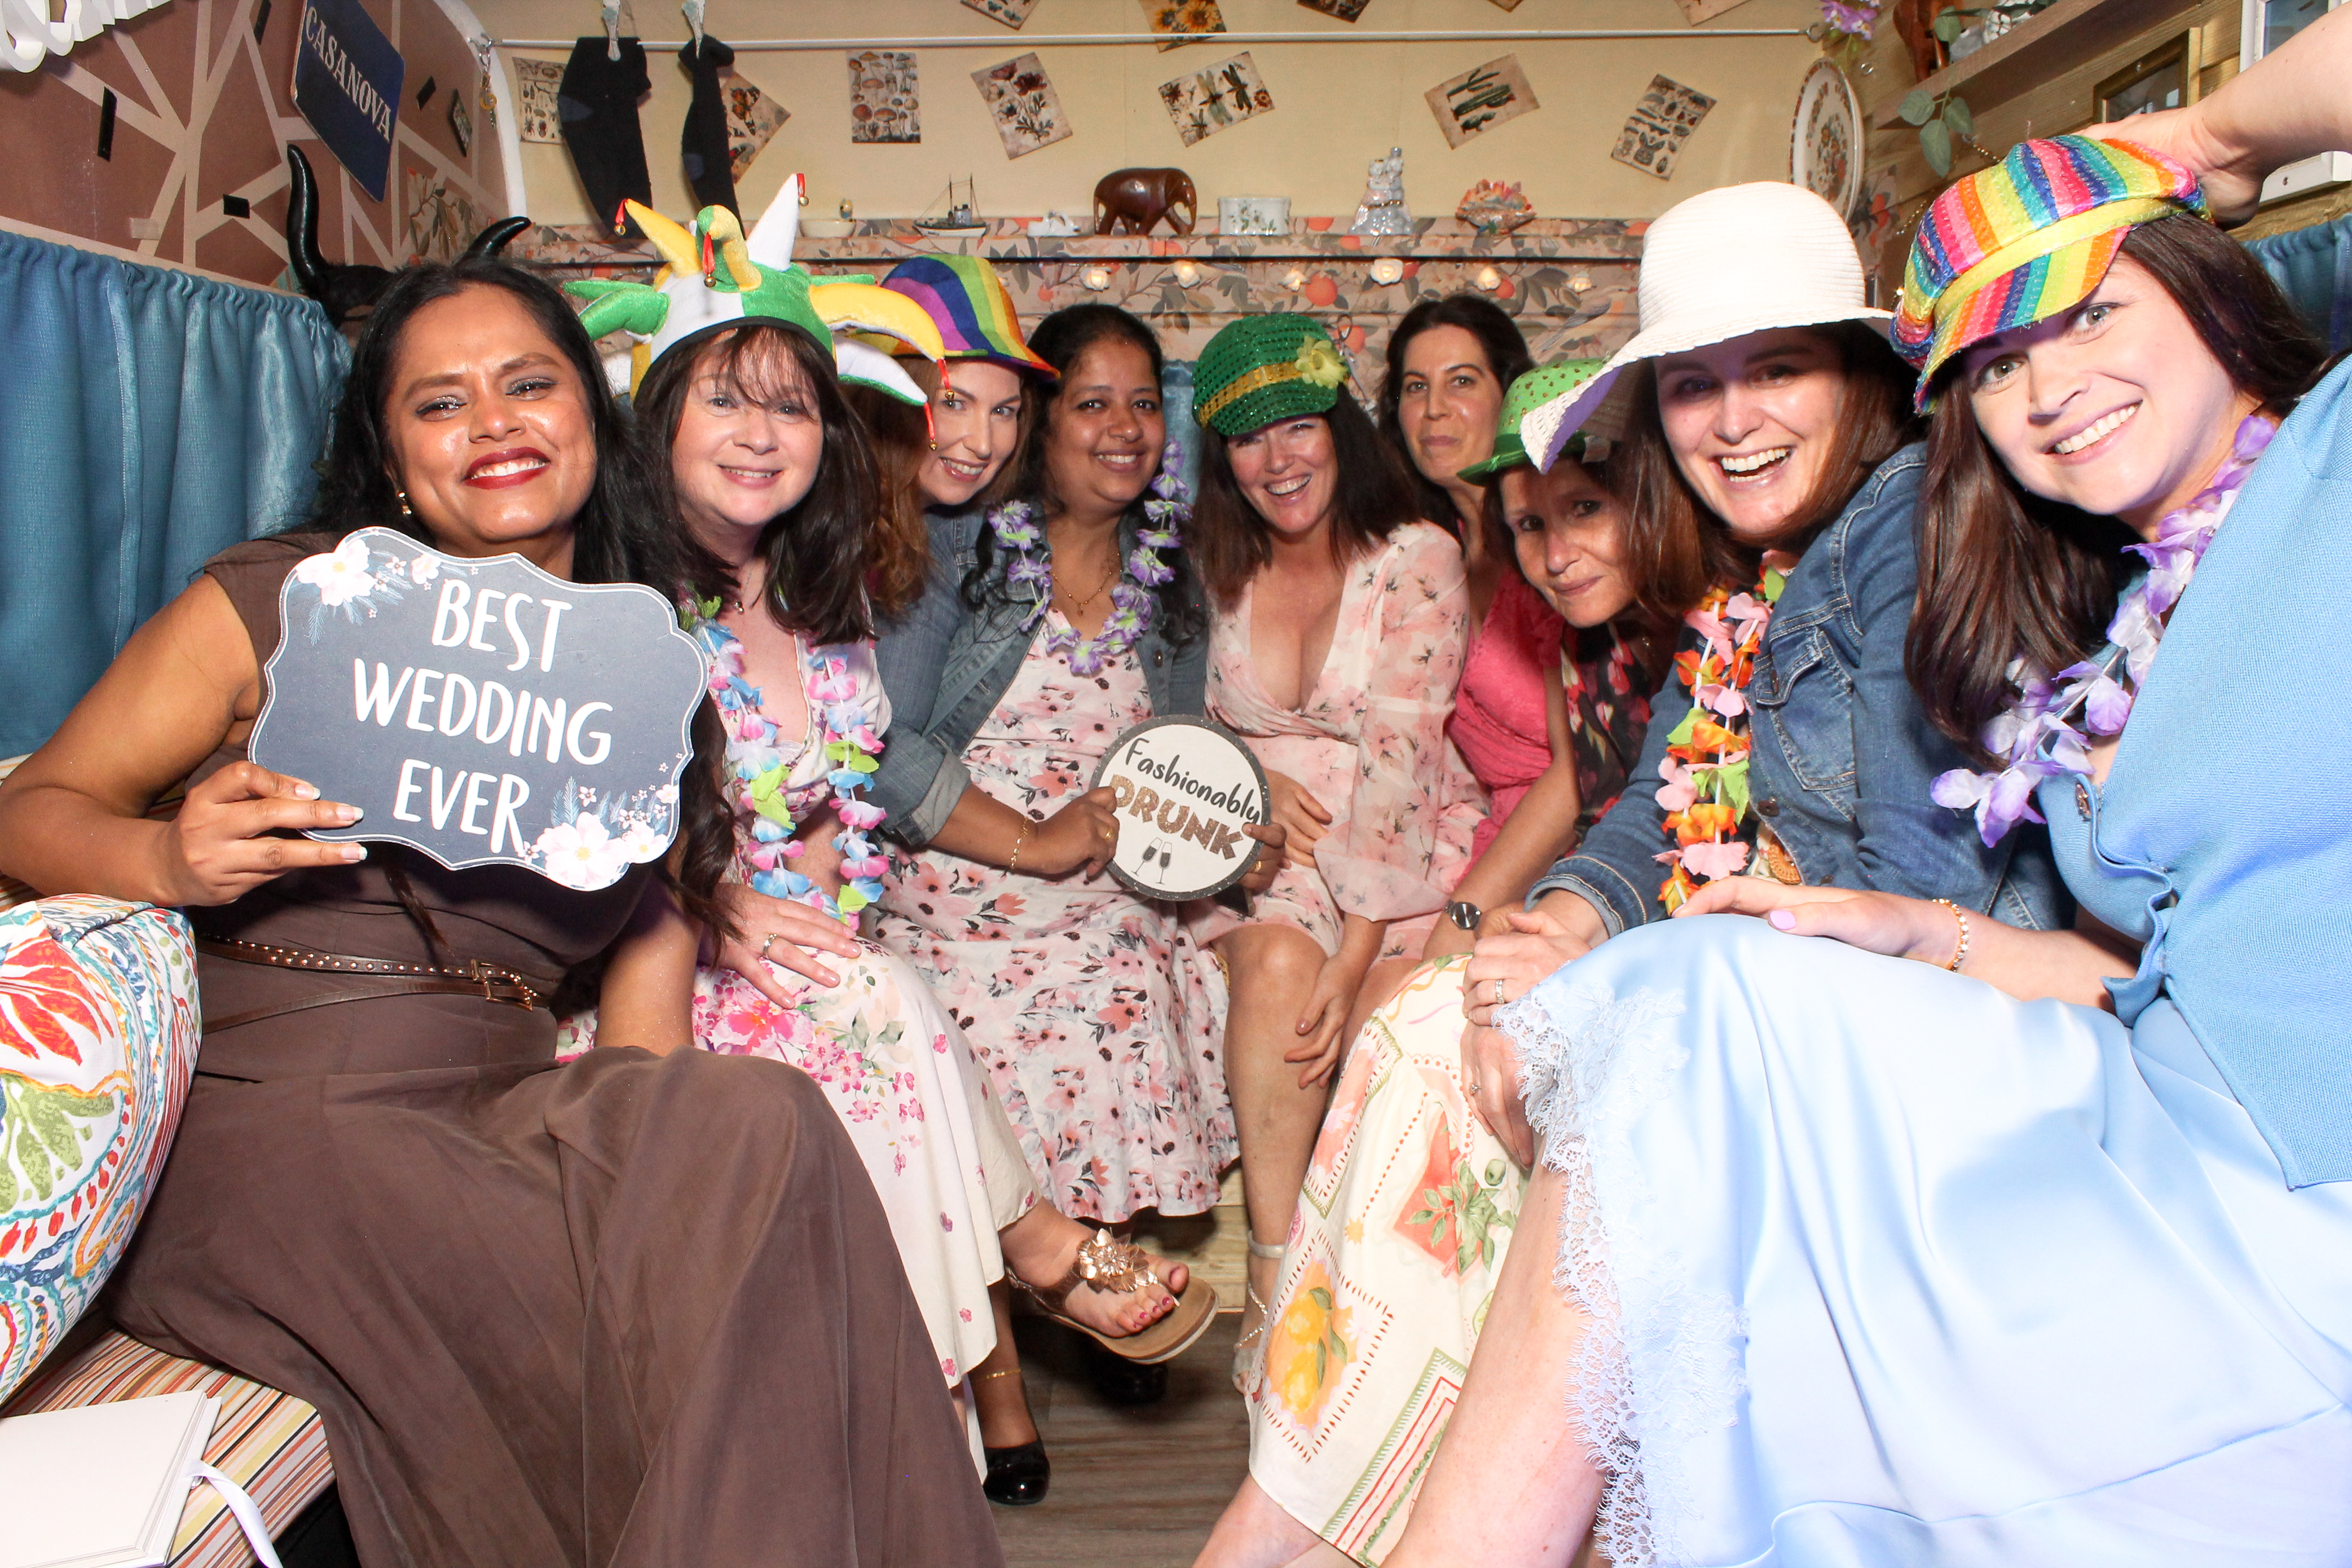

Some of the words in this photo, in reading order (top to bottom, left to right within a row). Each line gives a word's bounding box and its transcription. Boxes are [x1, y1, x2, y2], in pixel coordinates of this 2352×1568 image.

[306, 7, 391, 141] CASANOVA
[432, 579, 572, 672] BEST
[355, 658, 613, 765] WEDDING
[393, 759, 530, 853] EVER
[1109, 774, 1243, 860] DRUNK
[1125, 737, 1260, 824] Fashionably
